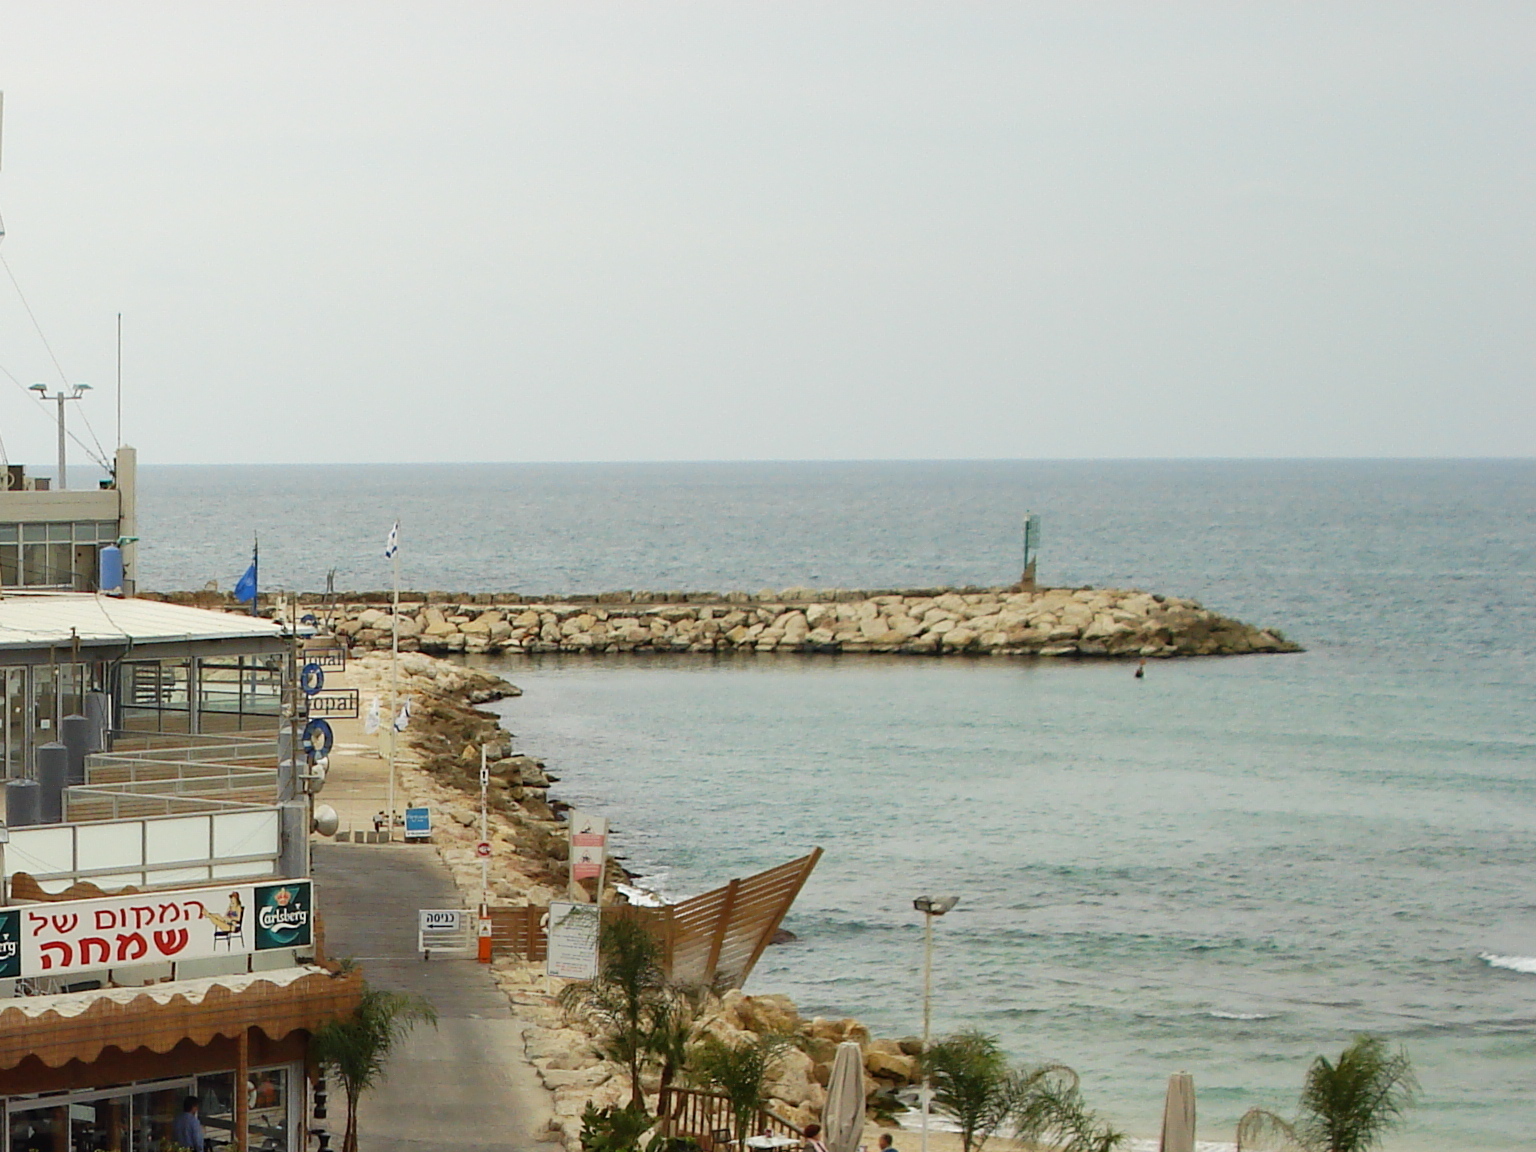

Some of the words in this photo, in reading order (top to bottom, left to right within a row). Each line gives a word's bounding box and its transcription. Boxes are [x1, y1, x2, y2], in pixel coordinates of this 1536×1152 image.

[313, 693, 353, 715] opal
[28, 911, 78, 937] של
[93, 898, 206, 931] המקום
[259, 902, 308, 932] Carlsberg
[426, 912, 455, 924] כניסה
[39, 926, 190, 970] שמחה
